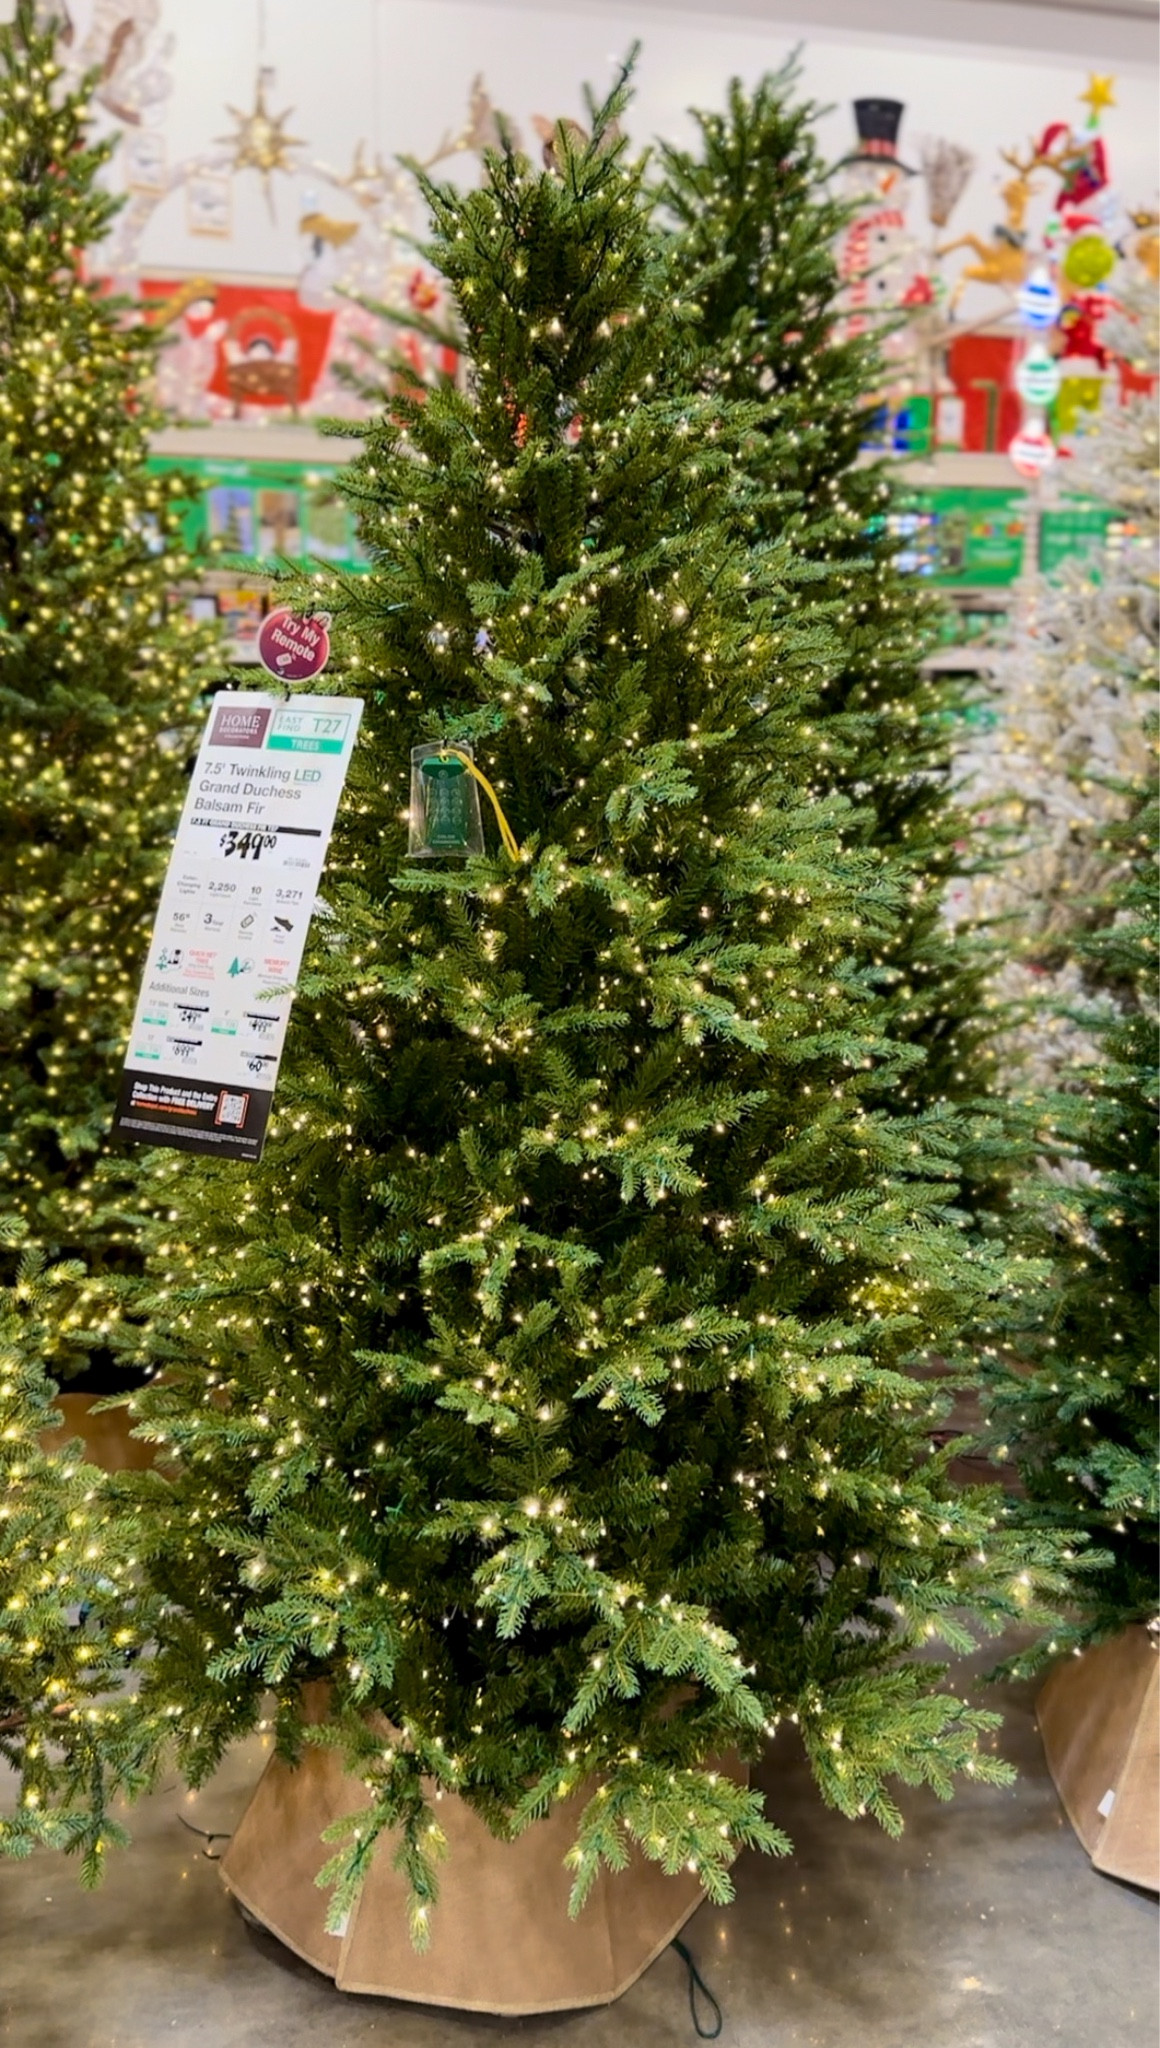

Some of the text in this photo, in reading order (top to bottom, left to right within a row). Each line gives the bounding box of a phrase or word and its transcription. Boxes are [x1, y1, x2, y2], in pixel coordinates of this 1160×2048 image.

[282, 617, 320, 647] Try My
[271, 628, 315, 662] Remote
[220, 714, 261, 728] HOME
[313, 718, 341, 733] T27
[291, 739, 320, 752] TREES
[204, 762, 322, 783] 7.5' Twinkling LED
[199, 780, 302, 800] Grand Duchess
[194, 797, 265, 814] Balsam Fir
[208, 881, 236, 893] 2,250
[251, 886, 262, 895] 10
[276, 888, 303, 900] 3,271
[203, 912, 213, 925] 3
[149, 982, 210, 997] Additional Sizes
